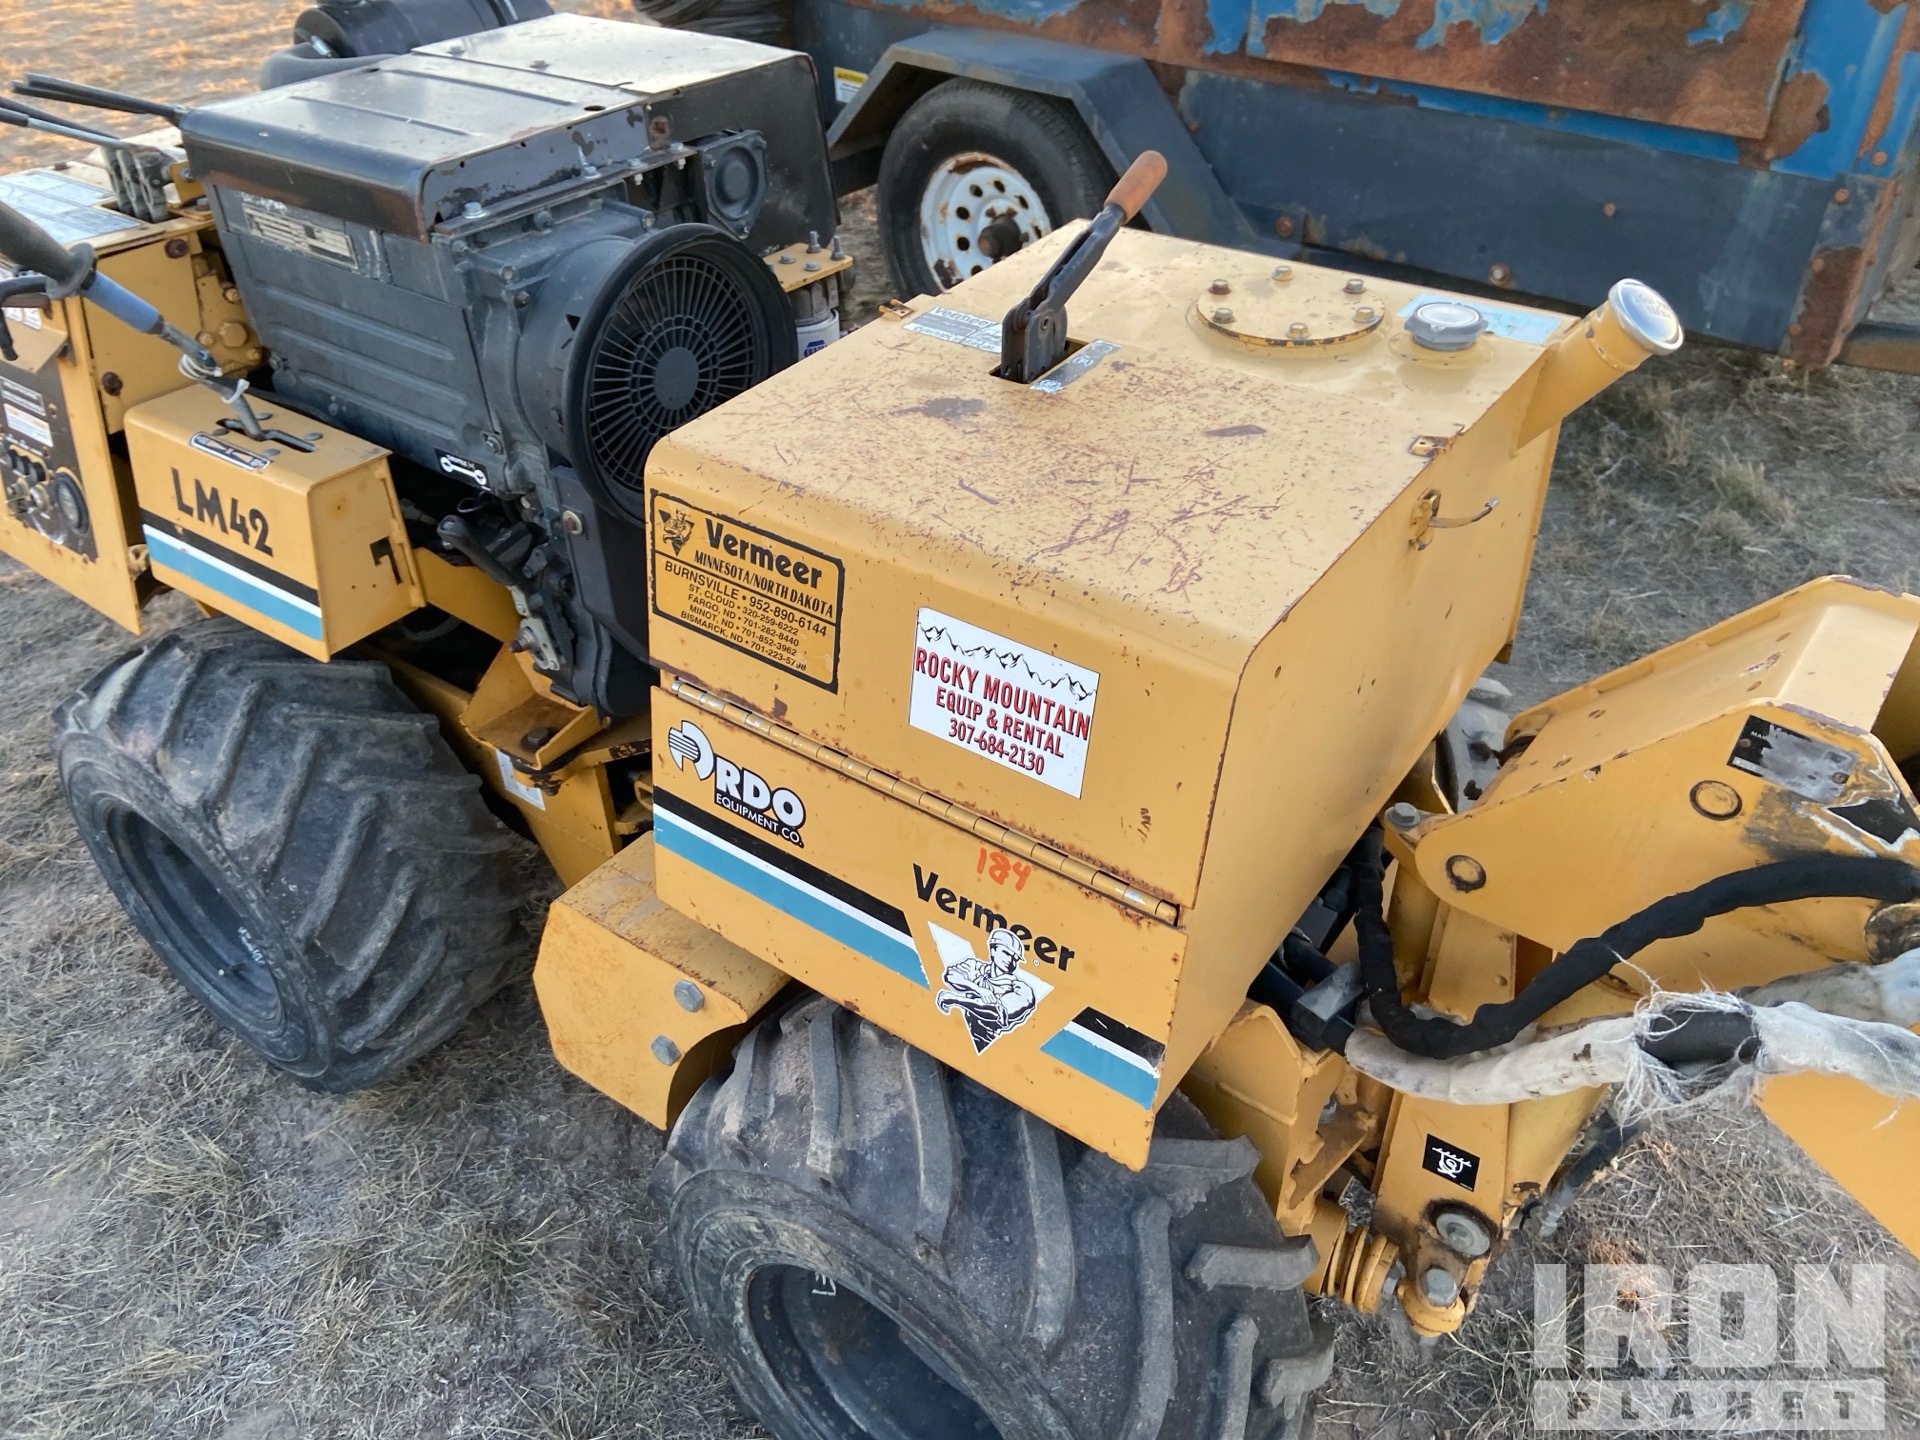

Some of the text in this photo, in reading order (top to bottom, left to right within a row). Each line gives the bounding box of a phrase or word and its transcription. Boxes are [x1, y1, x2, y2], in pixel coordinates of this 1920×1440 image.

[170, 466, 275, 558] LM42
[694, 550, 833, 618] MINNESOTA/NORTH DAKOTA
[705, 518, 822, 589] Vermeer
[665, 560, 828, 637] BURNSVILLE 952-890-6144
[680, 611, 728, 639] BISMARCK,
[730, 631, 744, 643] ND
[688, 584, 799, 635] ST. CLOUD 320-259-6222
[688, 594, 800, 647] FARGO, ND 701-282-8440
[689, 604, 797, 656] MINOT, ND 701-852-3962
[915, 646, 1091, 741] ROCKY MOUNTAIN
[935, 685, 1065, 758] EQUIP & RENTAL
[948, 717, 1045, 776] 307-684-2130
[716, 755, 806, 828] RDO
[716, 793, 803, 846] EQUIPMENT CO.
[976, 847, 1033, 892] 184
[912, 862, 1076, 972] Vermeer
